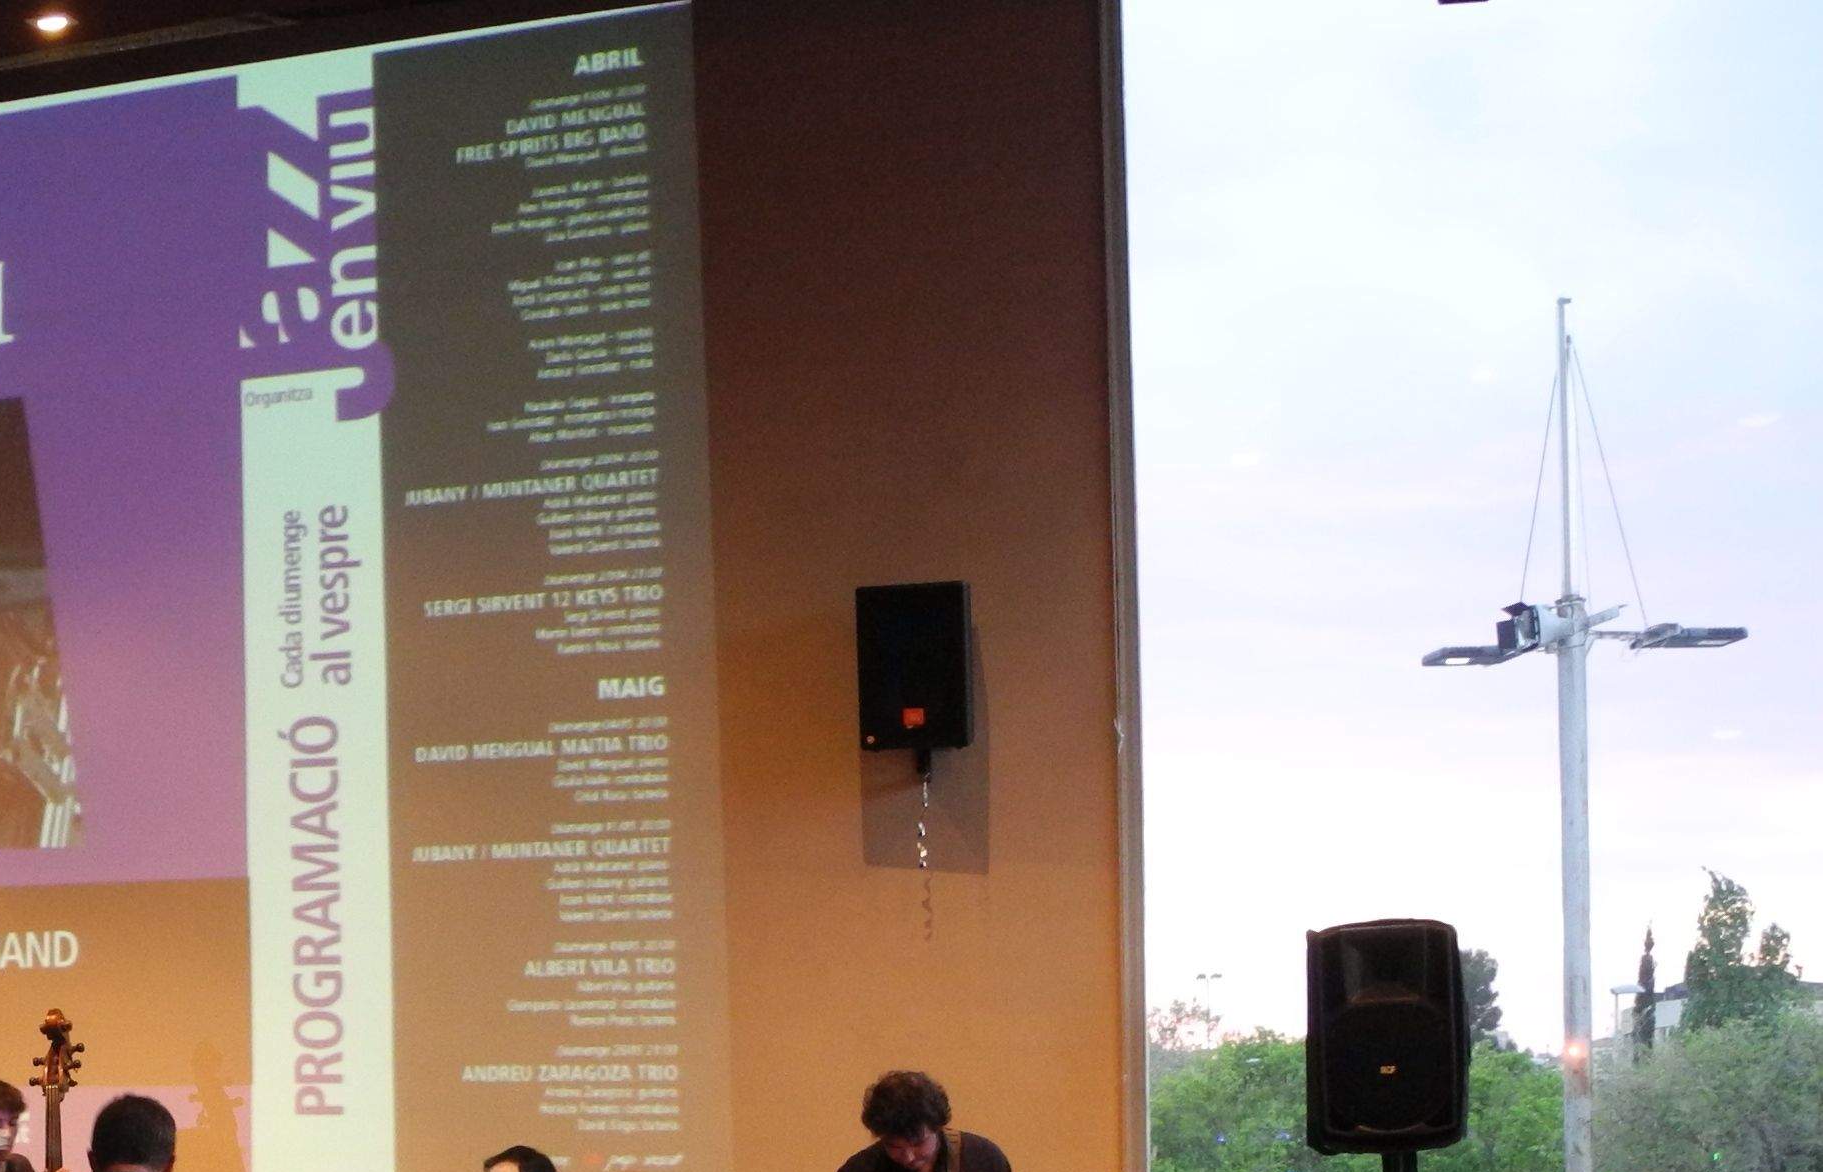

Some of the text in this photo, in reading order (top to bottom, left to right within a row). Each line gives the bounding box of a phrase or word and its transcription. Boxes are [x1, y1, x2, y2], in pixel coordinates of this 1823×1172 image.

[574, 47, 644, 76] ABRIL
[506, 102, 645, 135] DAVID MENGUAL
[456, 143, 493, 164] FREE
[499, 134, 558, 158] SPIRITS
[564, 129, 594, 149] BIG
[598, 122, 645, 144] BAND
[327, 106, 378, 350] en viu
[581, 467, 658, 492] QUARTET
[278, 509, 308, 690] Cada diumenge
[309, 504, 362, 686] al vespre
[424, 597, 471, 617] SERGI
[553, 590, 569, 607] 12
[576, 586, 618, 605] KEYS
[624, 583, 664, 602] TRIO
[597, 676, 665, 700] MAIG
[415, 744, 468, 763] DAVID
[473, 740, 554, 760] MENGUAL
[629, 733, 668, 752] TRIO
[592, 836, 672, 857] QUARTET
[277, 714, 346, 1116] PROGRAMACIÓ
[524, 958, 675, 977] ALBERT VILA TRIO
[462, 1064, 679, 1083] ANDREU ZARAGOZA TRIO
